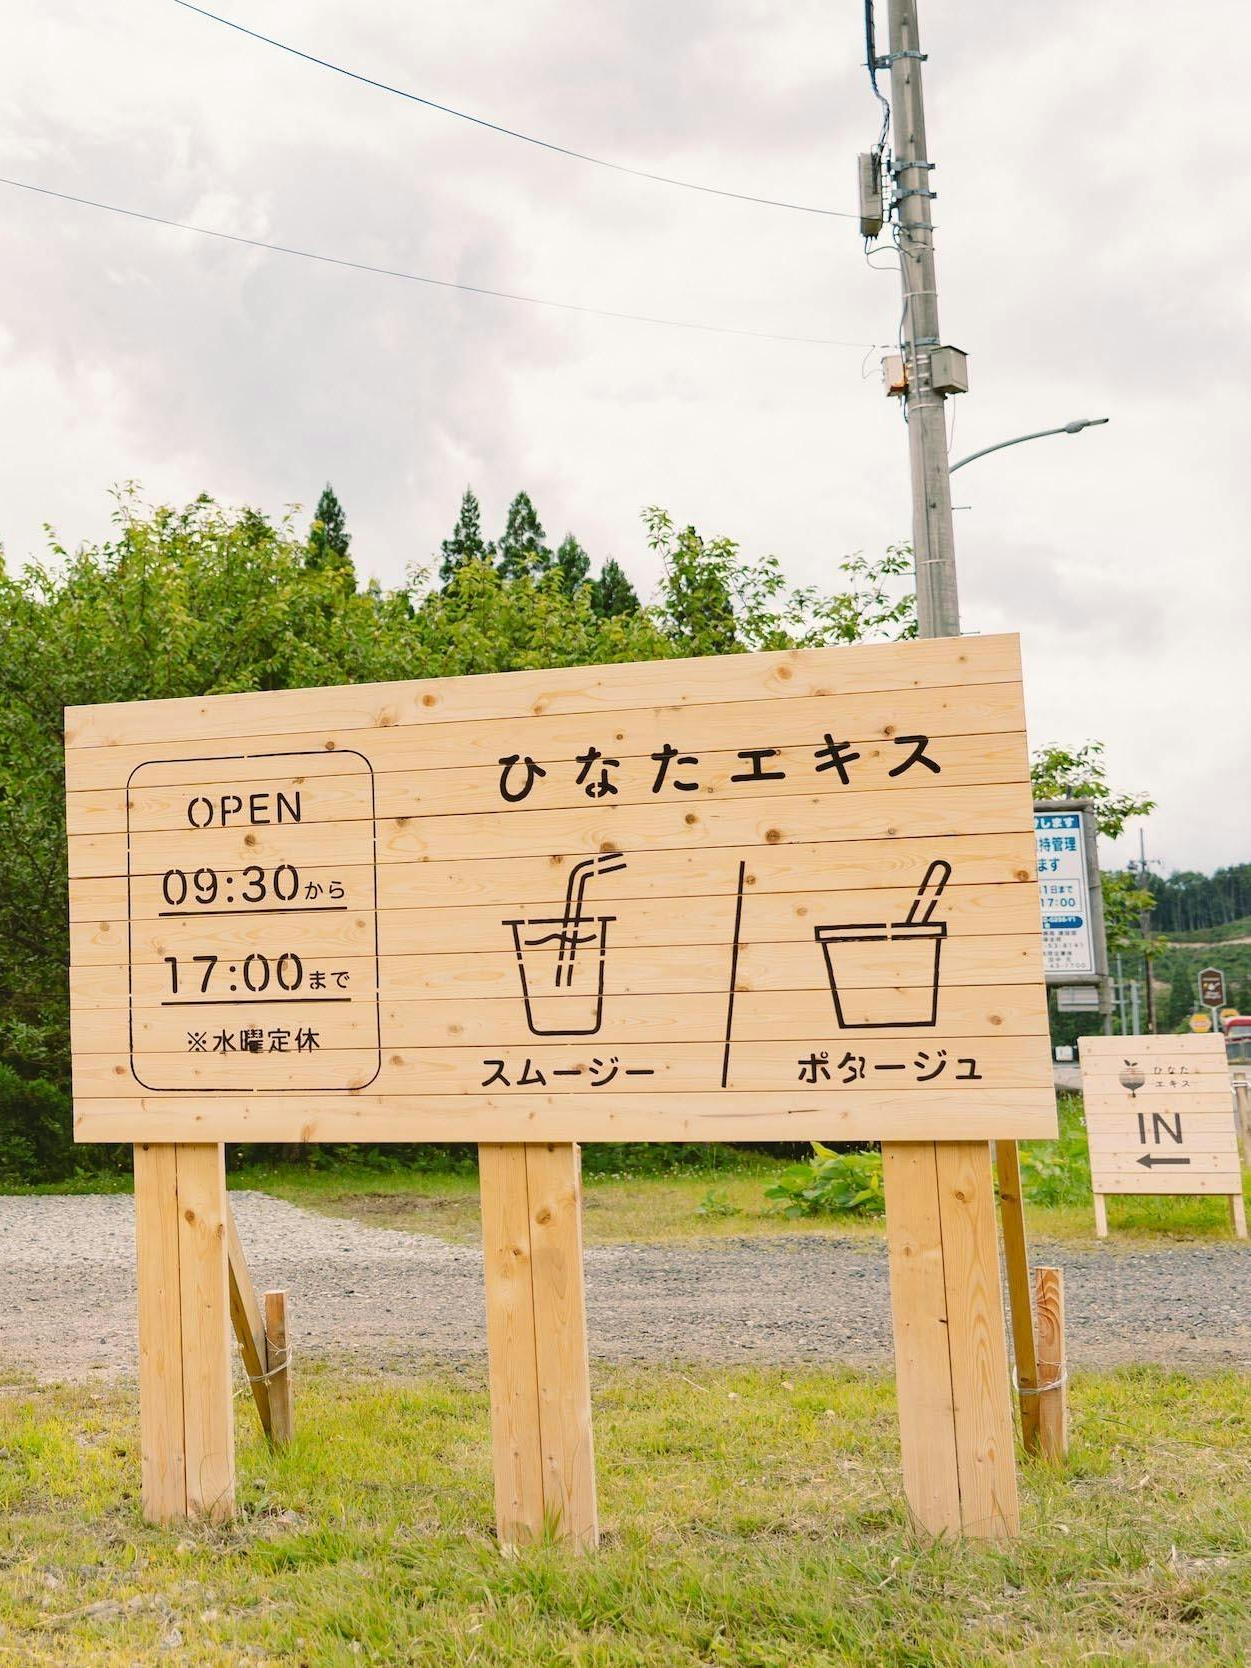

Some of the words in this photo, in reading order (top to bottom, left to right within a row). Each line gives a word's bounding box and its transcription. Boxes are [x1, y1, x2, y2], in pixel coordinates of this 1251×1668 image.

[498, 733, 942, 803] ひなたエキス
[187, 791, 302, 828] OPEN
[1039, 885, 1074, 894] 1日まで
[1040, 898, 1076, 907] 17:00
[481, 1057, 655, 1087] スムージー
[797, 1049, 983, 1084] ポタージュ
[1155, 1080, 1190, 1088] エキス
[1137, 1112, 1183, 1144] IN
